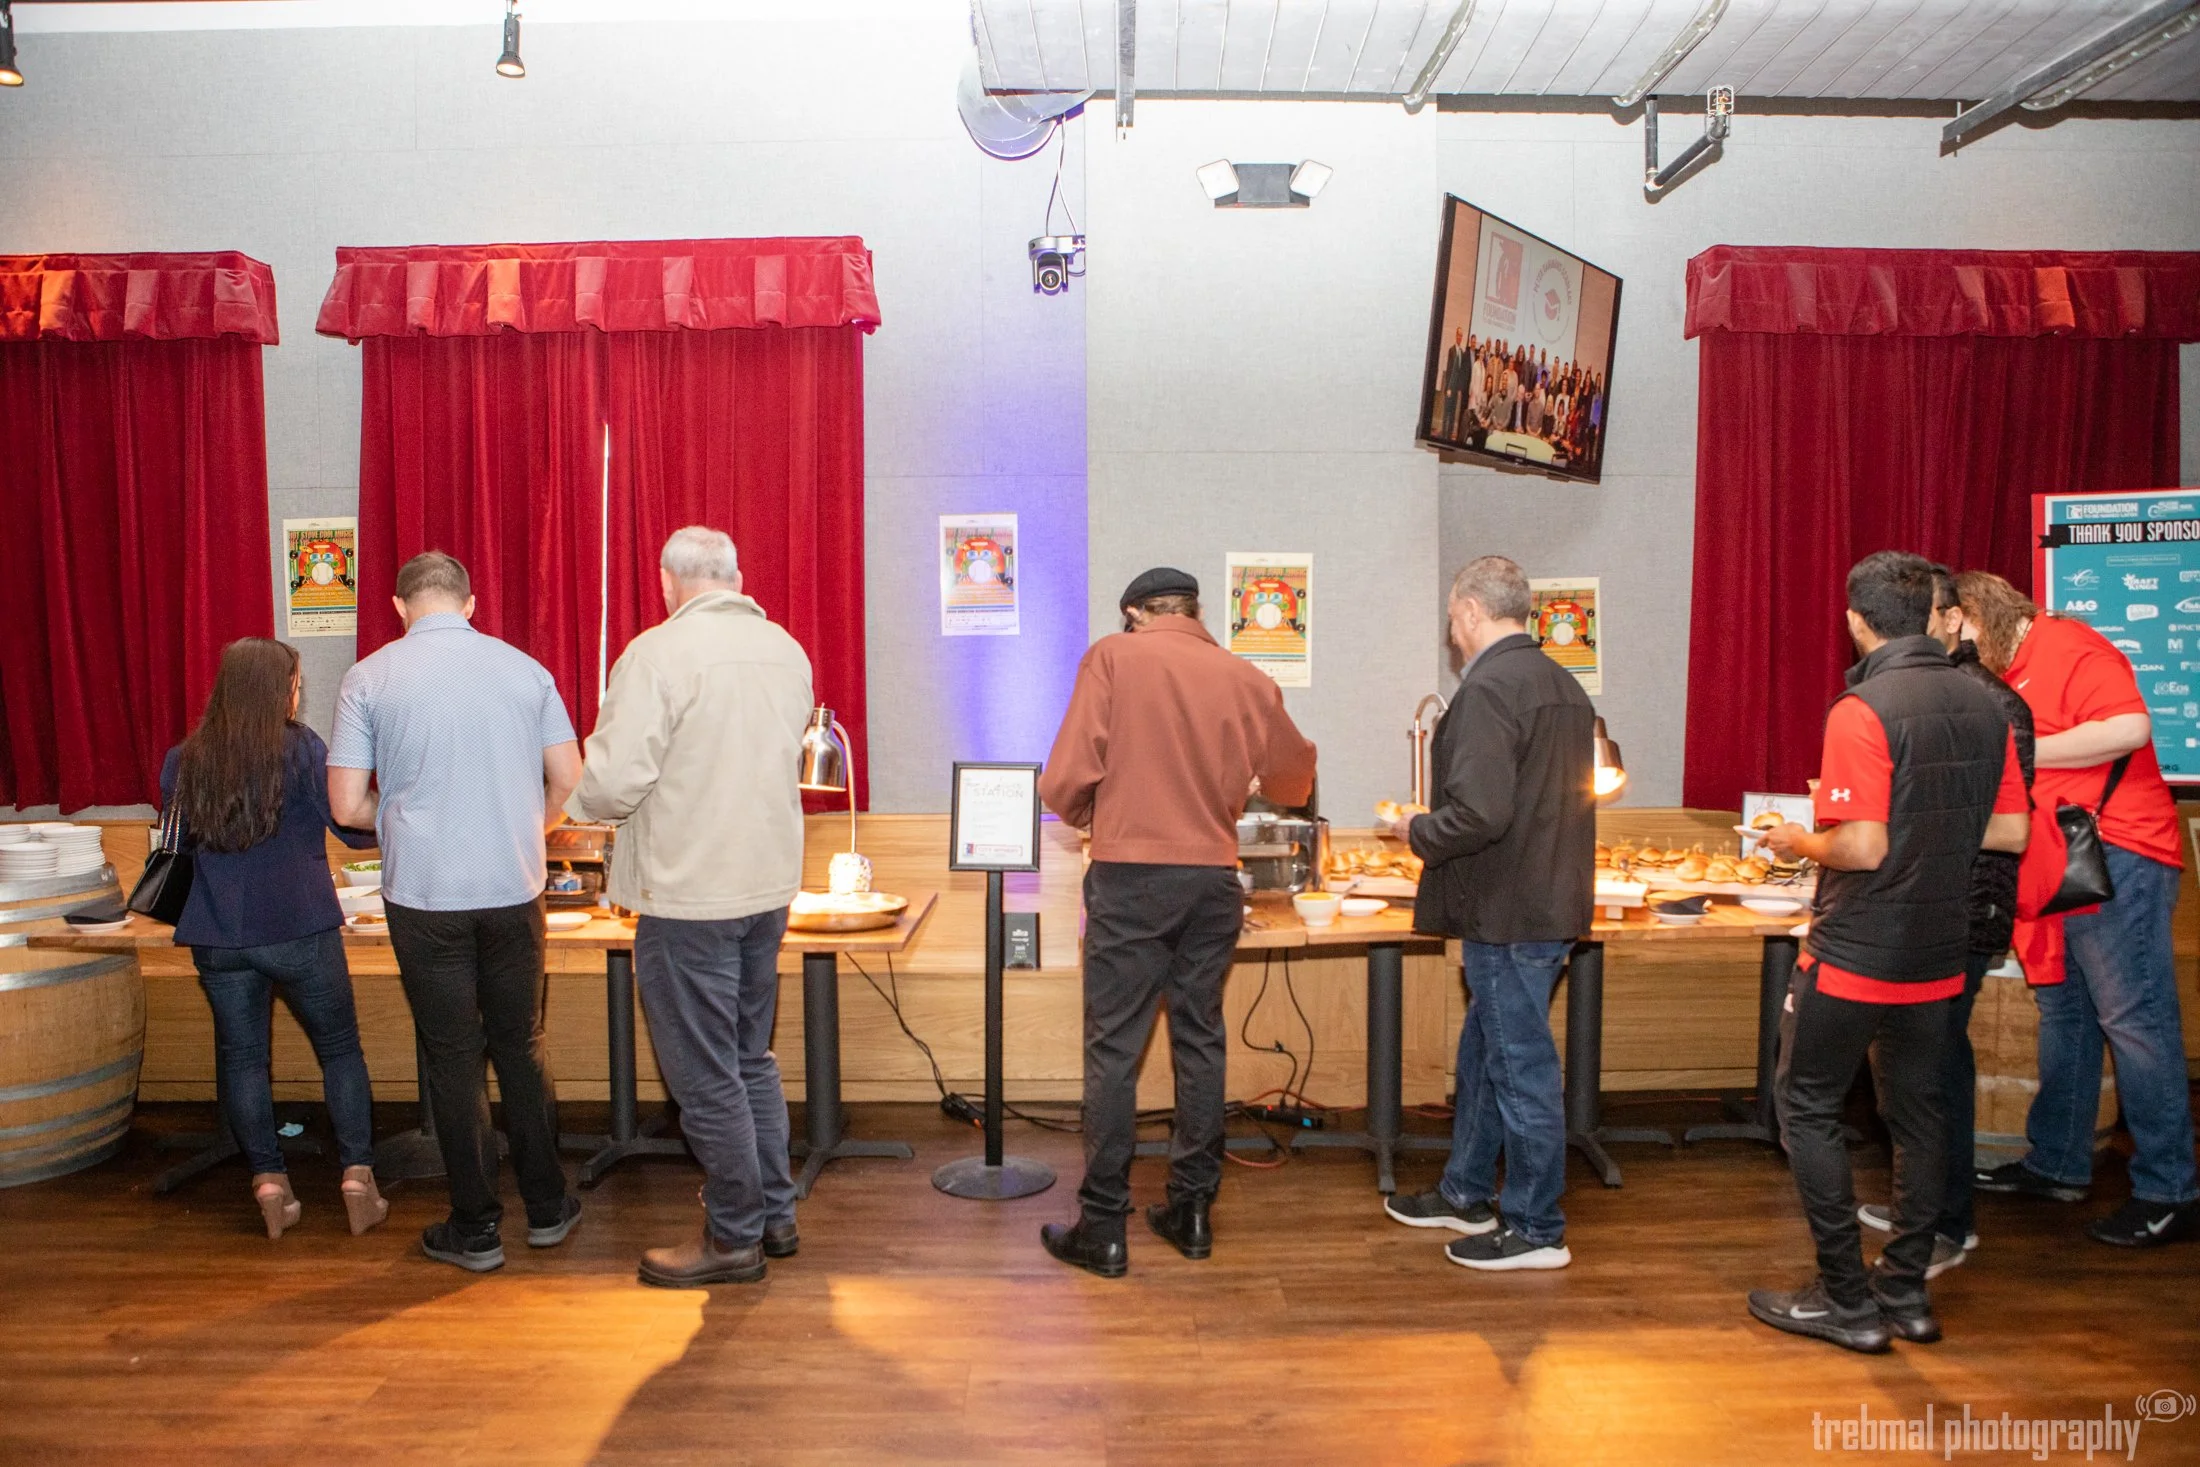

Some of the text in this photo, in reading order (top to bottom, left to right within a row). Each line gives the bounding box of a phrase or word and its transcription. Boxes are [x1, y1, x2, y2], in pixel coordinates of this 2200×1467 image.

[2083, 502, 2139, 514] FOUNDATION
[2068, 520, 2200, 544] THANK YOU SPONSO
[2065, 600, 2098, 611] A&G
[973, 787, 1024, 798] STATION
